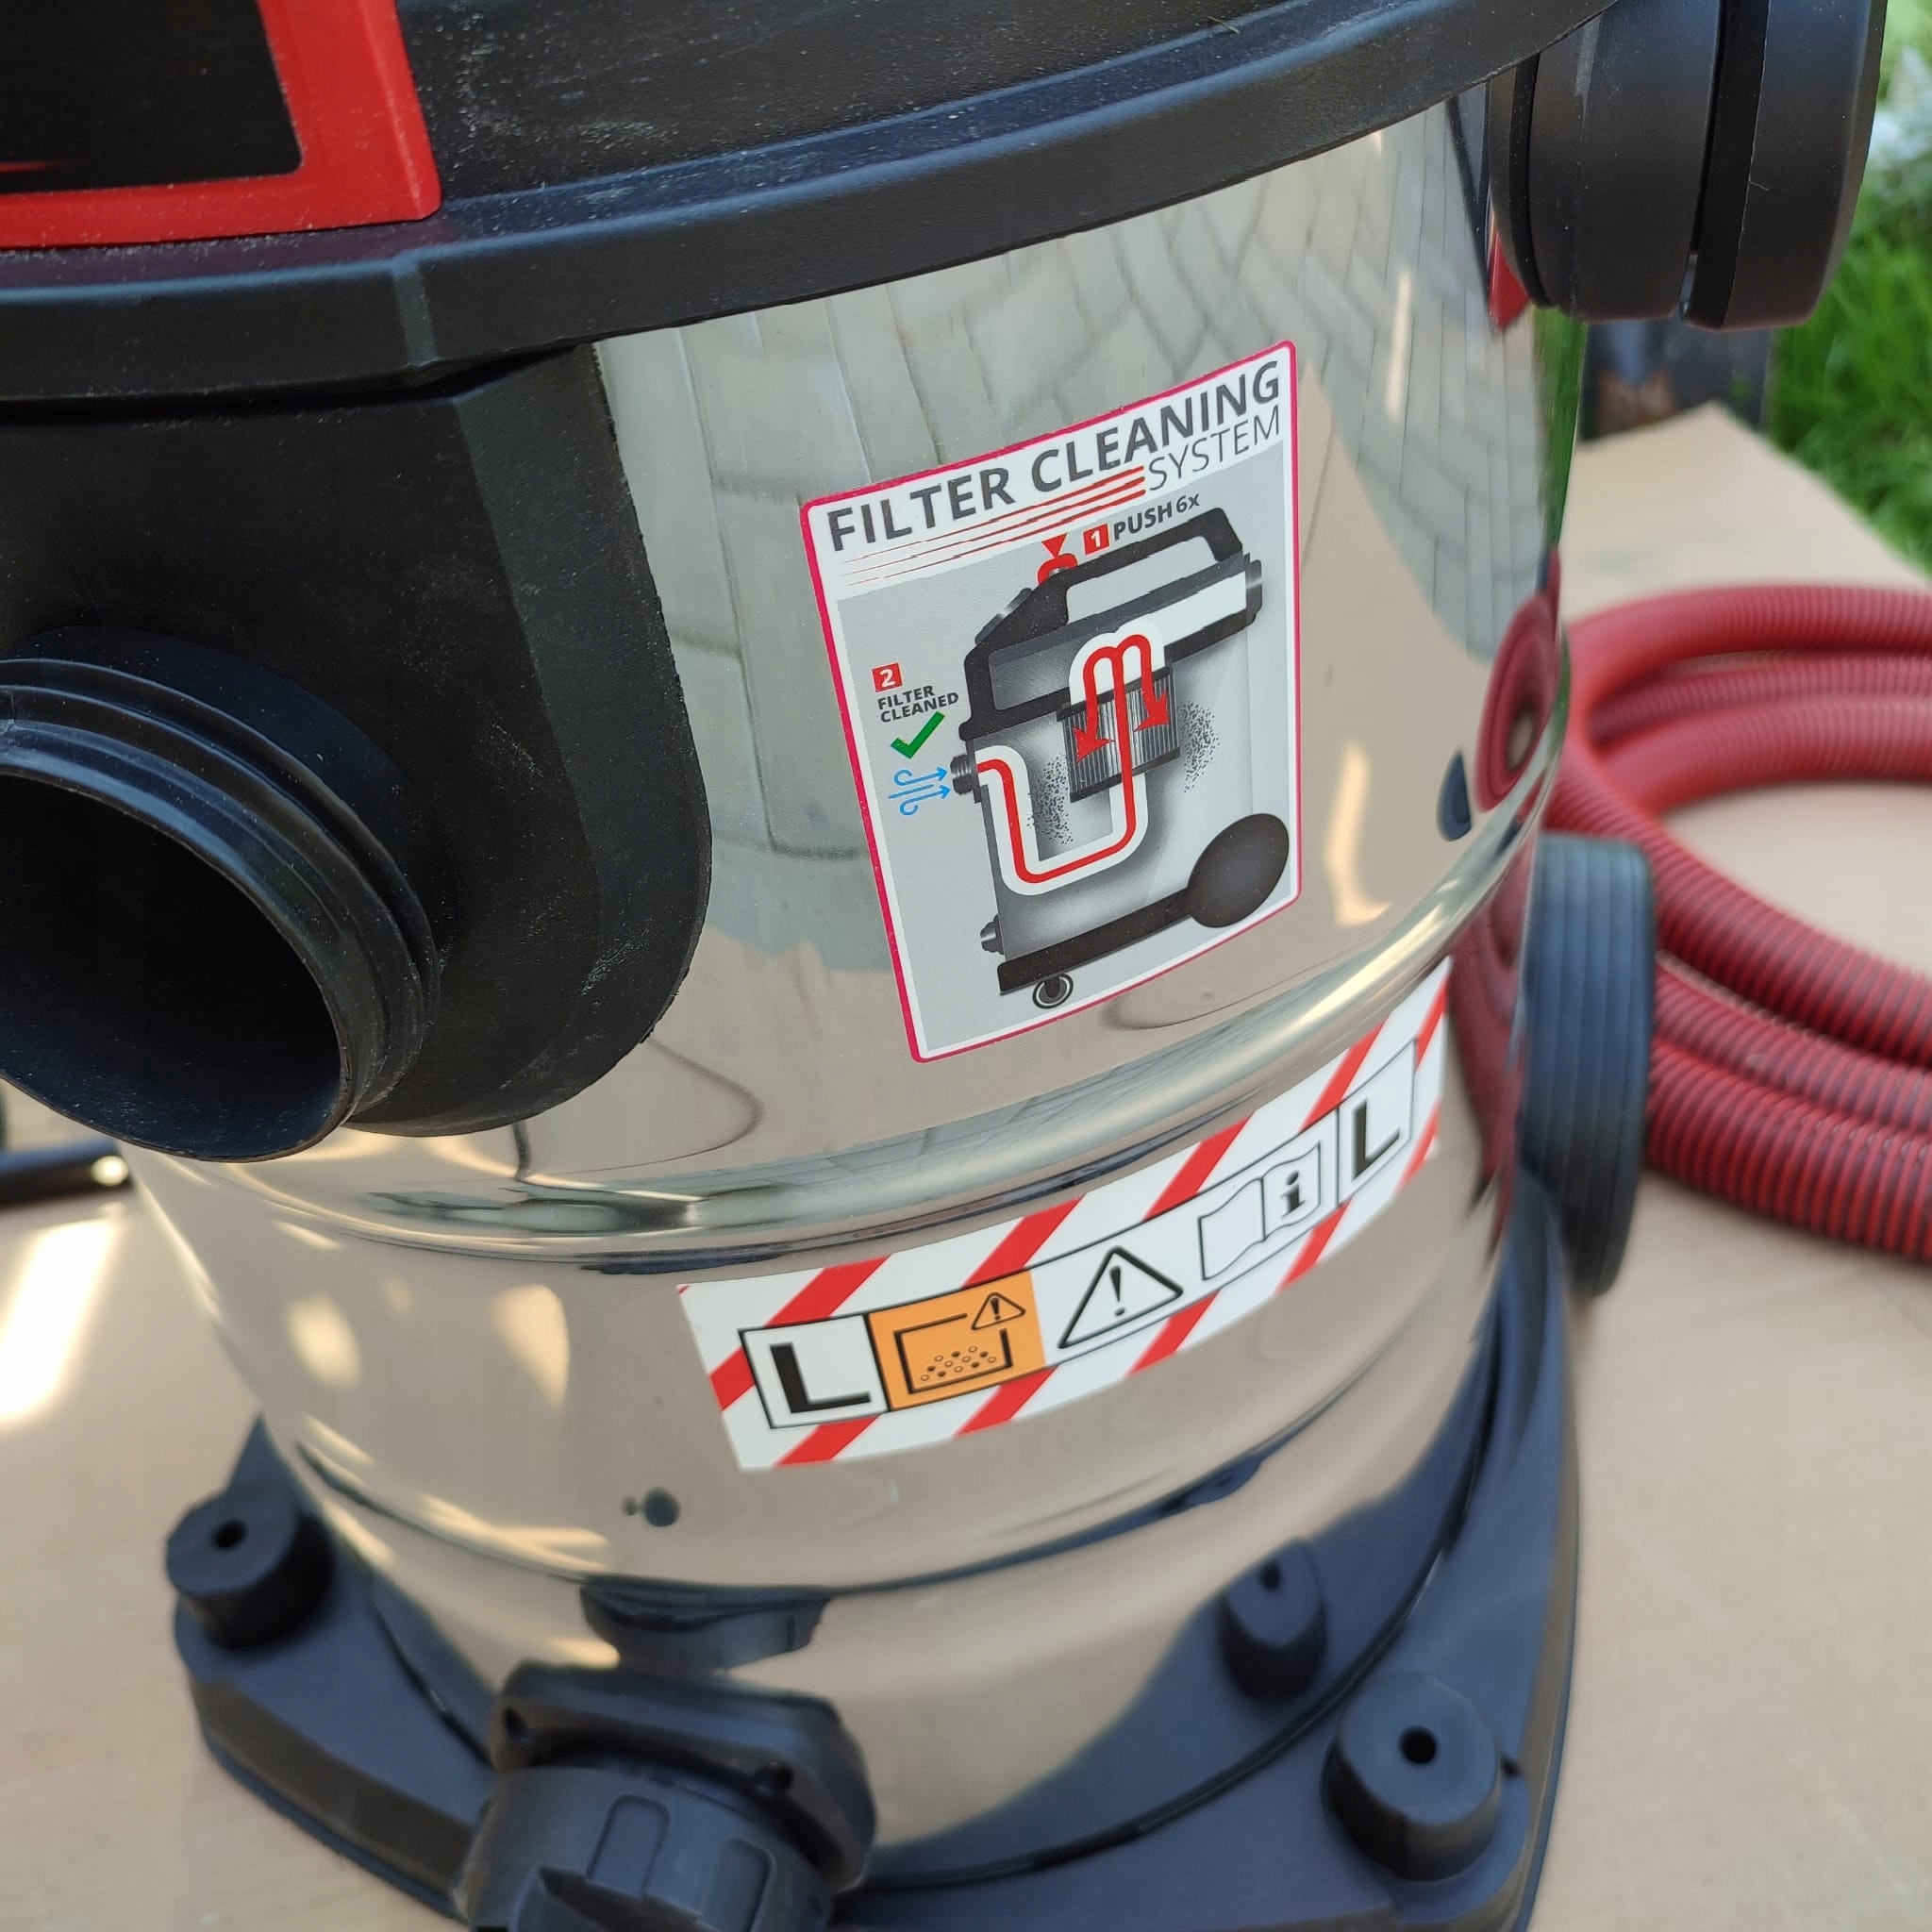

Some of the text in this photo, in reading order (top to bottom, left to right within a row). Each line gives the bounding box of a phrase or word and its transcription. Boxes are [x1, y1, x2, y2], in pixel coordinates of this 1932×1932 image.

[826, 360, 1280, 552] FILTER CLEANING
[1148, 405, 1281, 491] SYSTEM
[1090, 492, 1201, 550] 1 PUSH 6x
[877, 685, 935, 710] FILTER
[880, 691, 959, 723] CLEANED
[881, 668, 894, 688] 2
[769, 1342, 871, 1414] L
[1352, 1101, 1400, 1180] L
